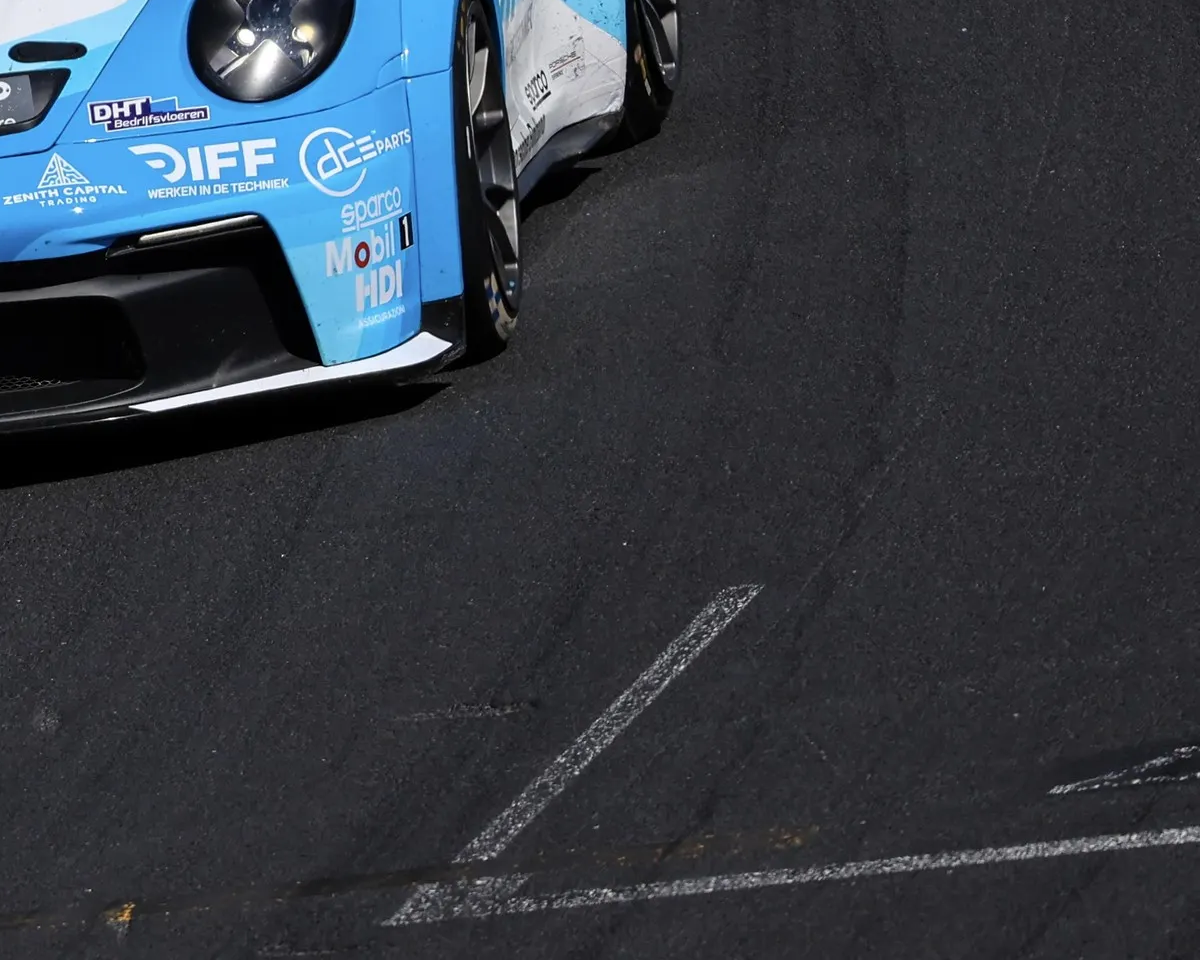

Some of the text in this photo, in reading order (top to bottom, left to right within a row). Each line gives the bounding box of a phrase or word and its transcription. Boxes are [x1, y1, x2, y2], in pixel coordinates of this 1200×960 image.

[93, 98, 147, 122] DHT
[114, 110, 205, 129] Bedrijfsvloeren
[375, 128, 412, 155] PARTS
[128, 137, 277, 184] DIFF
[2, 184, 128, 206] ZENITH CAPITAL
[147, 177, 289, 200] WERKEN IN DE TECHNIEK
[39, 196, 97, 208] TRADING
[341, 186, 402, 231] sparco
[325, 220, 396, 278] Mobil
[355, 259, 403, 313] HDI
